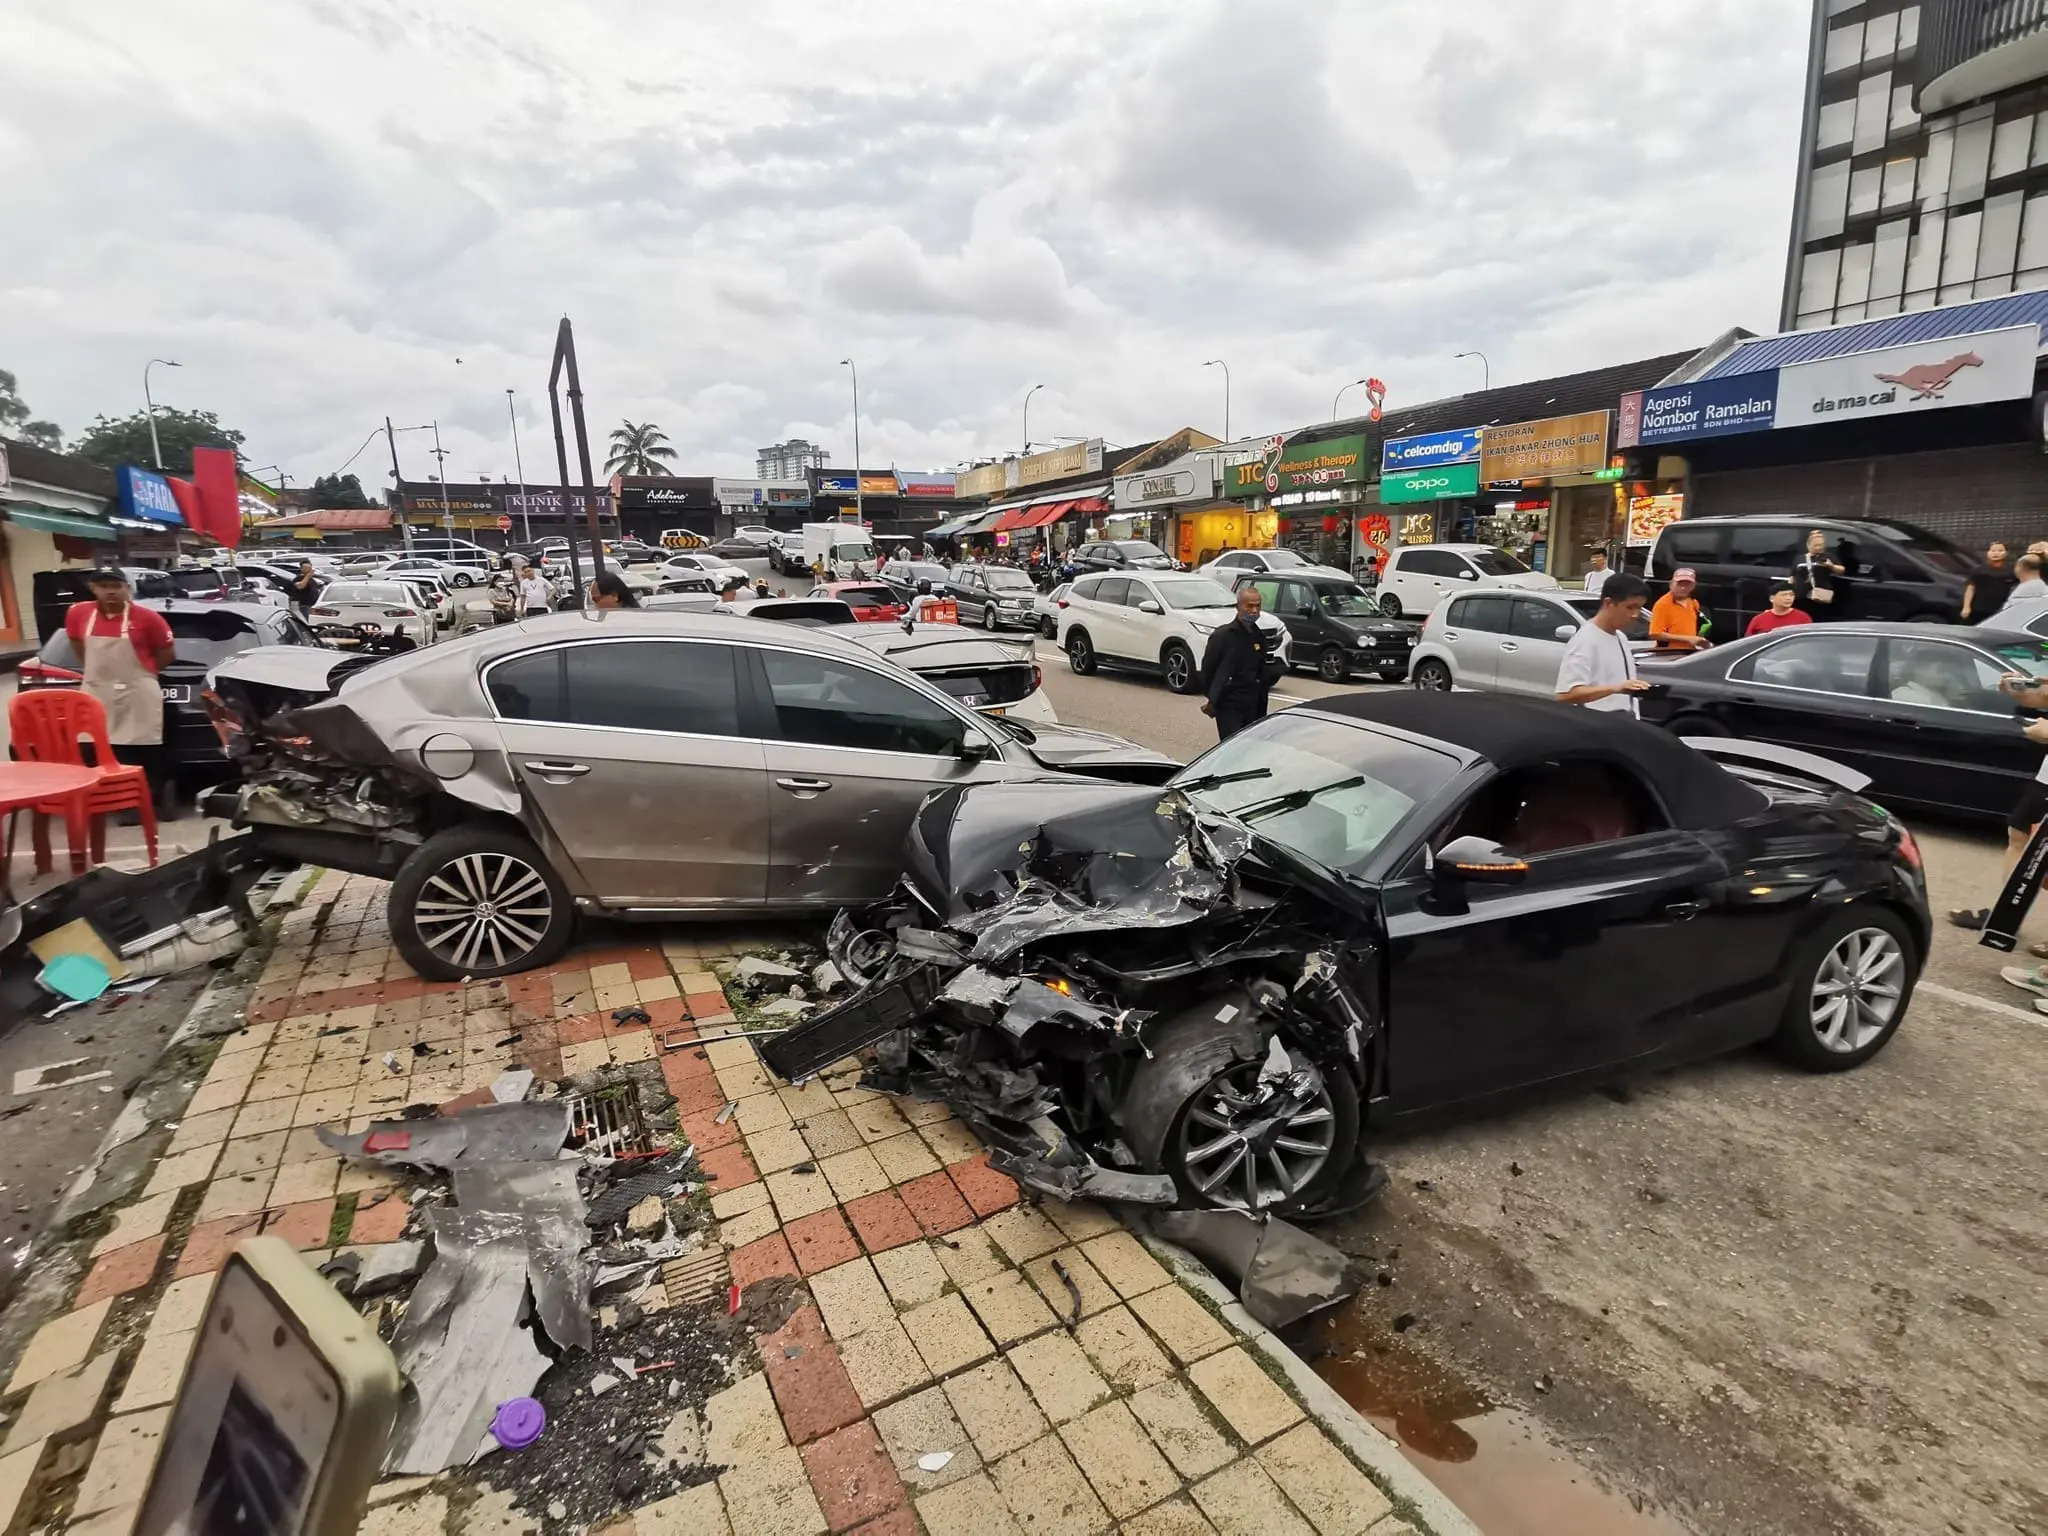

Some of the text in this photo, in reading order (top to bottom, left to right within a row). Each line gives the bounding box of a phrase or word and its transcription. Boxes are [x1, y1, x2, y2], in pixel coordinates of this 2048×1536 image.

[1645, 391, 1692, 414] Agensi
[1812, 387, 1896, 413] da ma cai
[1642, 398, 1771, 428] Nombor Ramalan
[1487, 426, 1535, 441] RESTORAN
[1642, 423, 1697, 437] BETTERMATE
[1703, 420, 1722, 428] SDN
[1723, 417, 1743, 426] BHD
[1403, 440, 1463, 458] celcomdigi
[1486, 433, 1600, 456] IKAN BAKAR ZHONG HUA
[1279, 453, 1357, 473] Wellness & Therapy
[1238, 463, 1264, 485] JTC
[1405, 478, 1449, 489] oppo
[646, 489, 686, 499] Adeline
